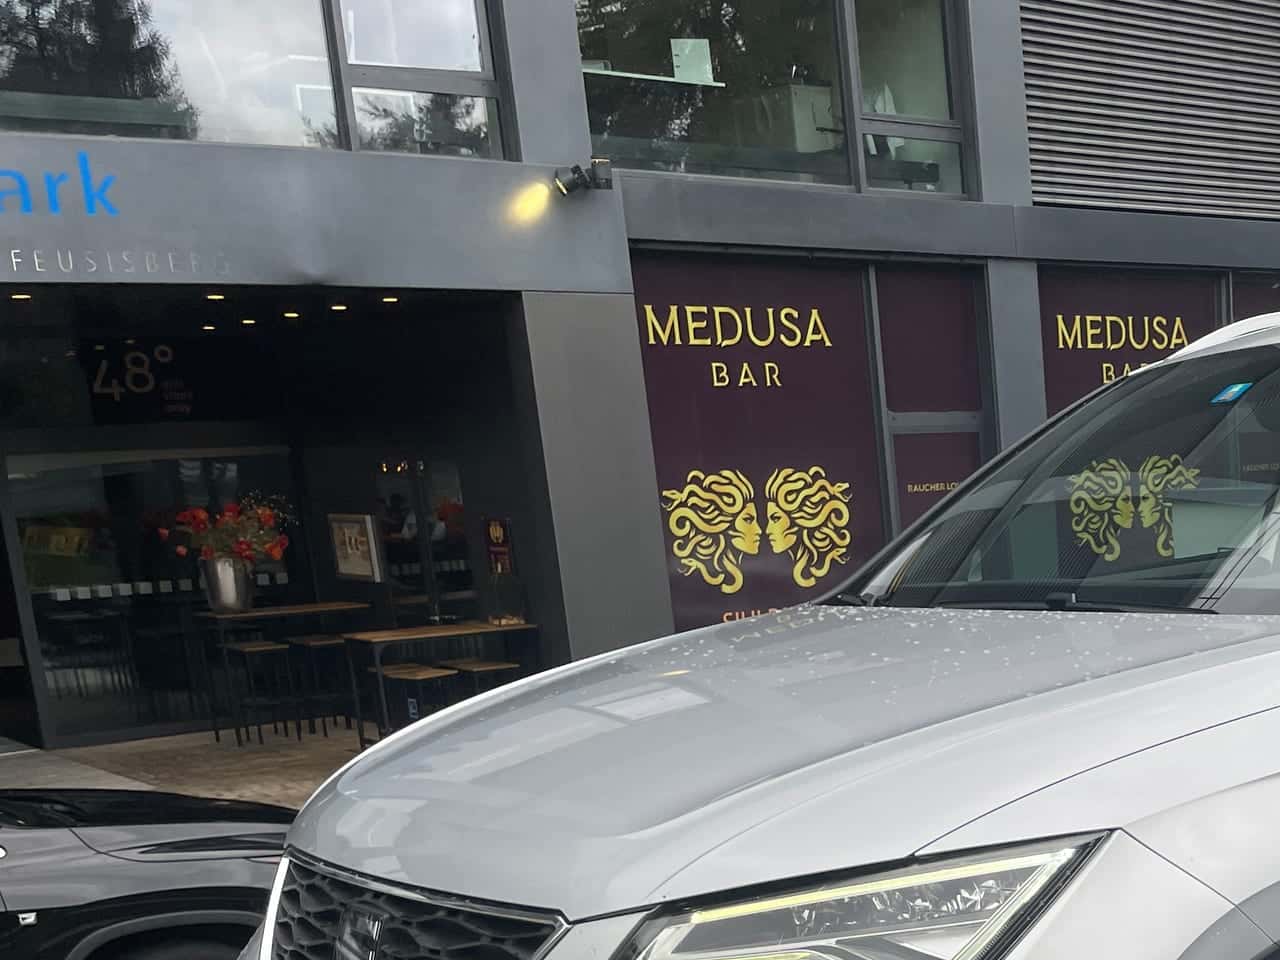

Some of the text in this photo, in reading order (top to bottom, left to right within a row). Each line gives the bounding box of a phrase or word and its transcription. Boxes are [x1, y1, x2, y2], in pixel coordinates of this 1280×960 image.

[643, 304, 833, 348] MEDUSA
[1056, 314, 1189, 351] MEDUSA
[711, 361, 783, 388] BAR
